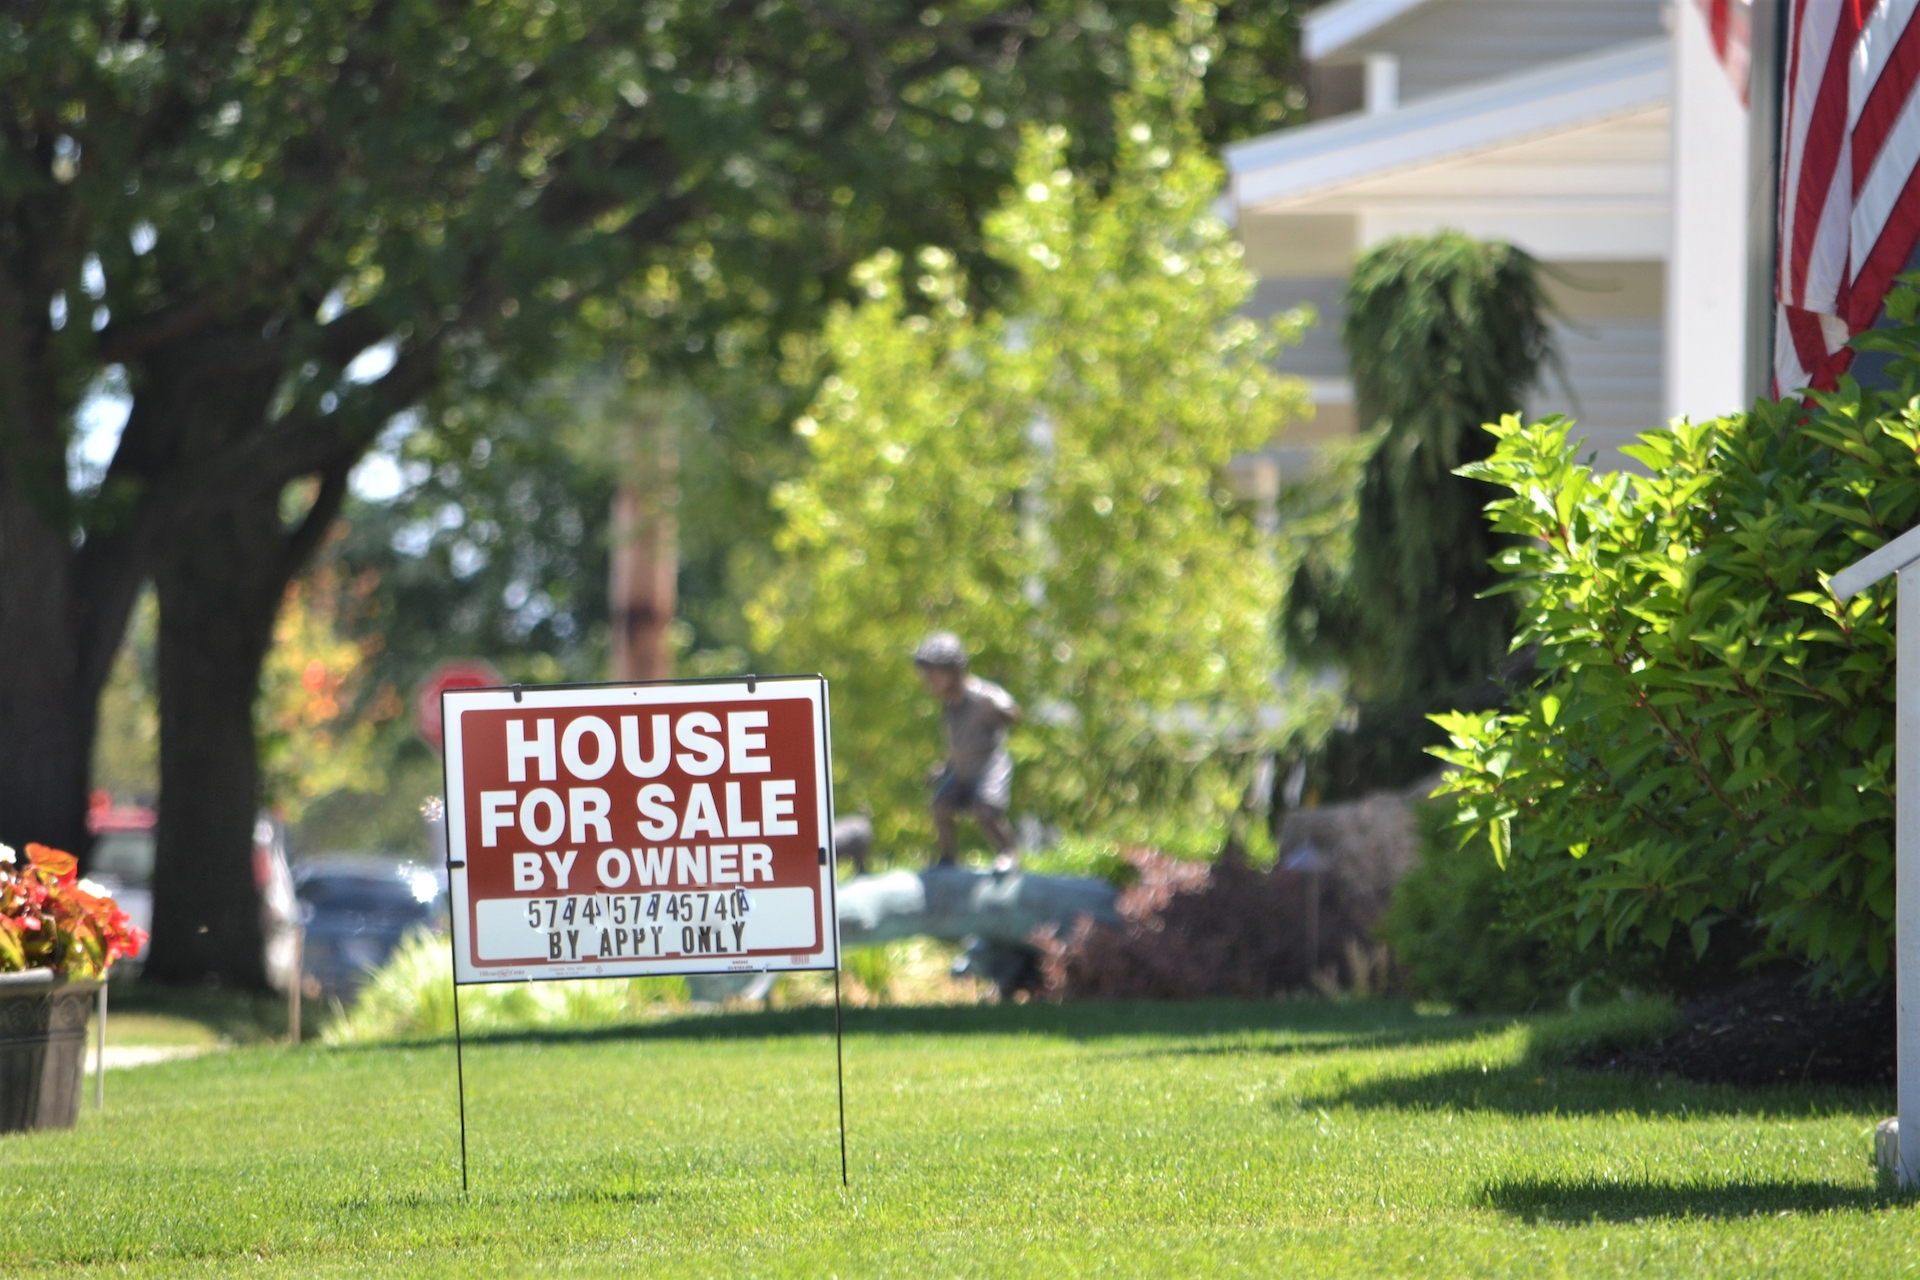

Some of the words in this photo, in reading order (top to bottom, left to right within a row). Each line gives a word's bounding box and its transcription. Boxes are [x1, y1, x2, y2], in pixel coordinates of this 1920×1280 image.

[506, 711, 771, 782] HOUSE
[480, 787, 613, 847] FOR
[636, 779, 798, 842] SALE
[513, 850, 578, 891] BY
[596, 843, 774, 888] OWNER
[549, 930, 579, 960] BY
[682, 921, 746, 954] ONLY
